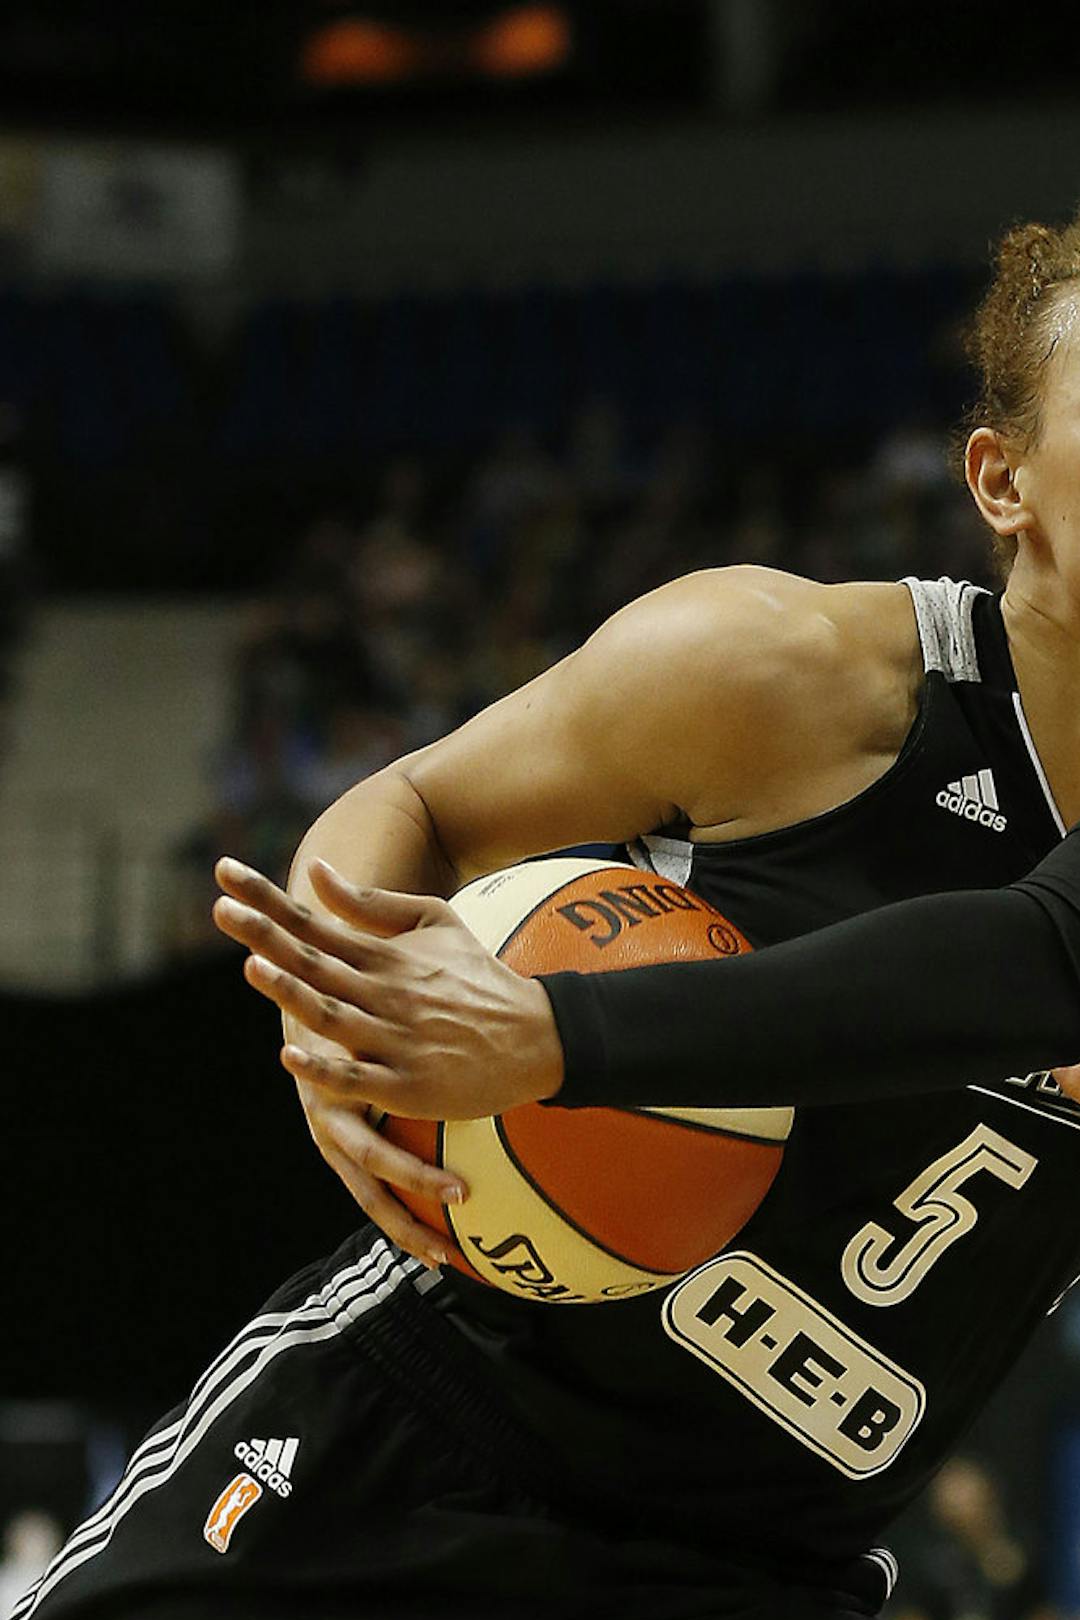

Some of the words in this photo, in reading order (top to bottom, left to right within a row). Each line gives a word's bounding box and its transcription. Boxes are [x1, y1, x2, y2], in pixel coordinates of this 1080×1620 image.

[936, 790, 1007, 832] adidas
[556, 884, 719, 950] DING
[841, 1122, 1039, 1307] 5
[234, 1441, 293, 1498] adidas
